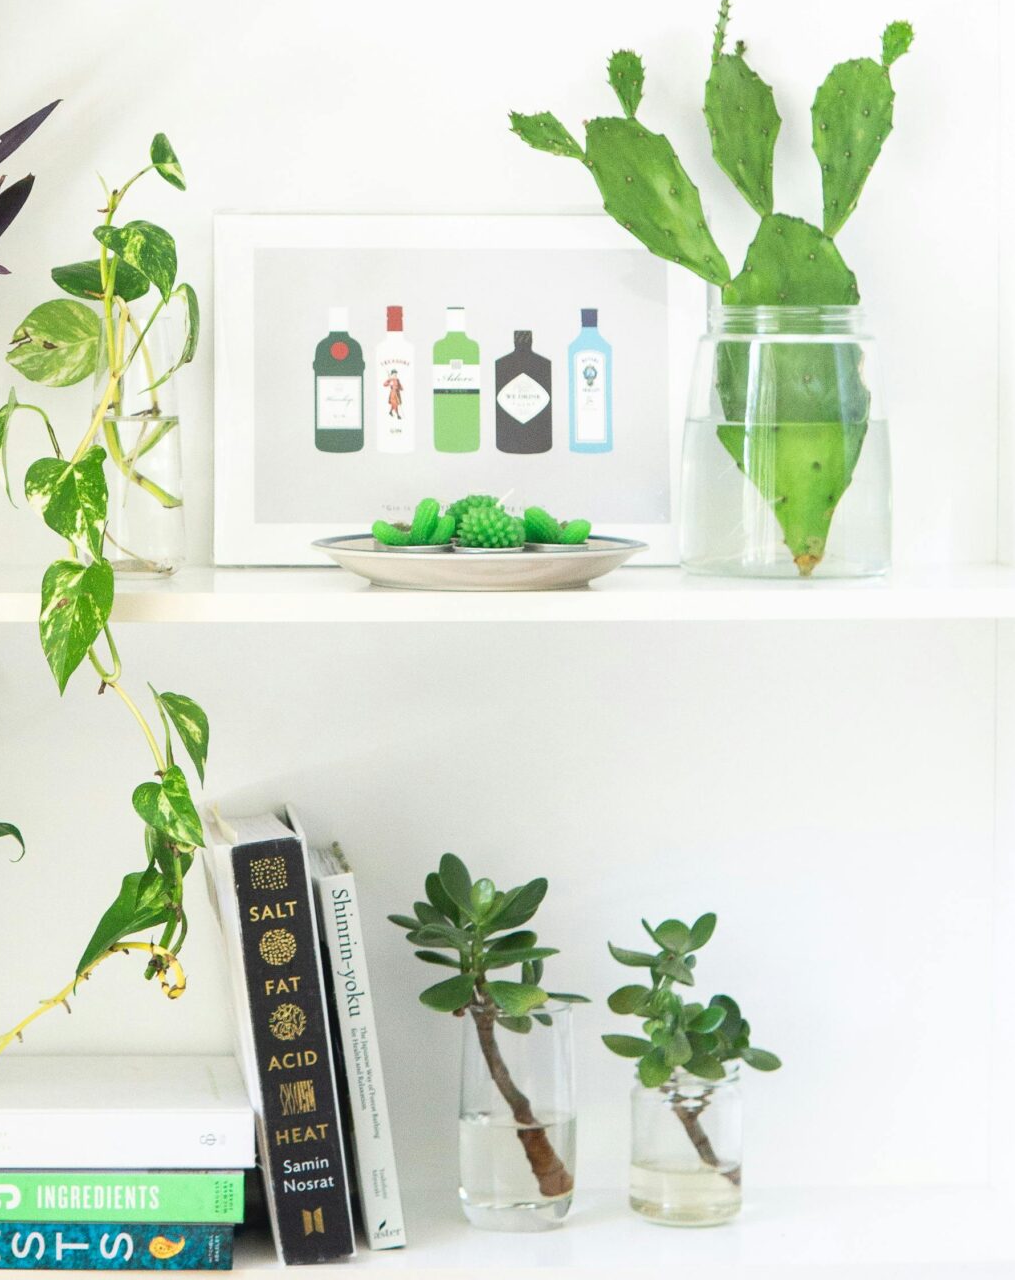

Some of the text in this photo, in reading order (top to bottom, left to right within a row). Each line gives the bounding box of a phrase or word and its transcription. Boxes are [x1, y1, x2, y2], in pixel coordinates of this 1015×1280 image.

[249, 901, 298, 922] SALT
[332, 889, 365, 1017] Shinrin-yoku
[265, 976, 301, 996] FAT
[351, 1028, 359, 1037] for
[360, 1026, 368, 1039] The
[352, 1039, 362, 1062] Health
[268, 1050, 318, 1072] ACID
[356, 1063, 364, 1075] and
[366, 1069, 374, 1082] Way
[368, 1084, 376, 1092] of
[275, 1123, 329, 1146] HEAT
[283, 1156, 330, 1174] Samin
[283, 1176, 335, 1193] Nosrat
[37, 1185, 159, 1209] INGREDIENTS
